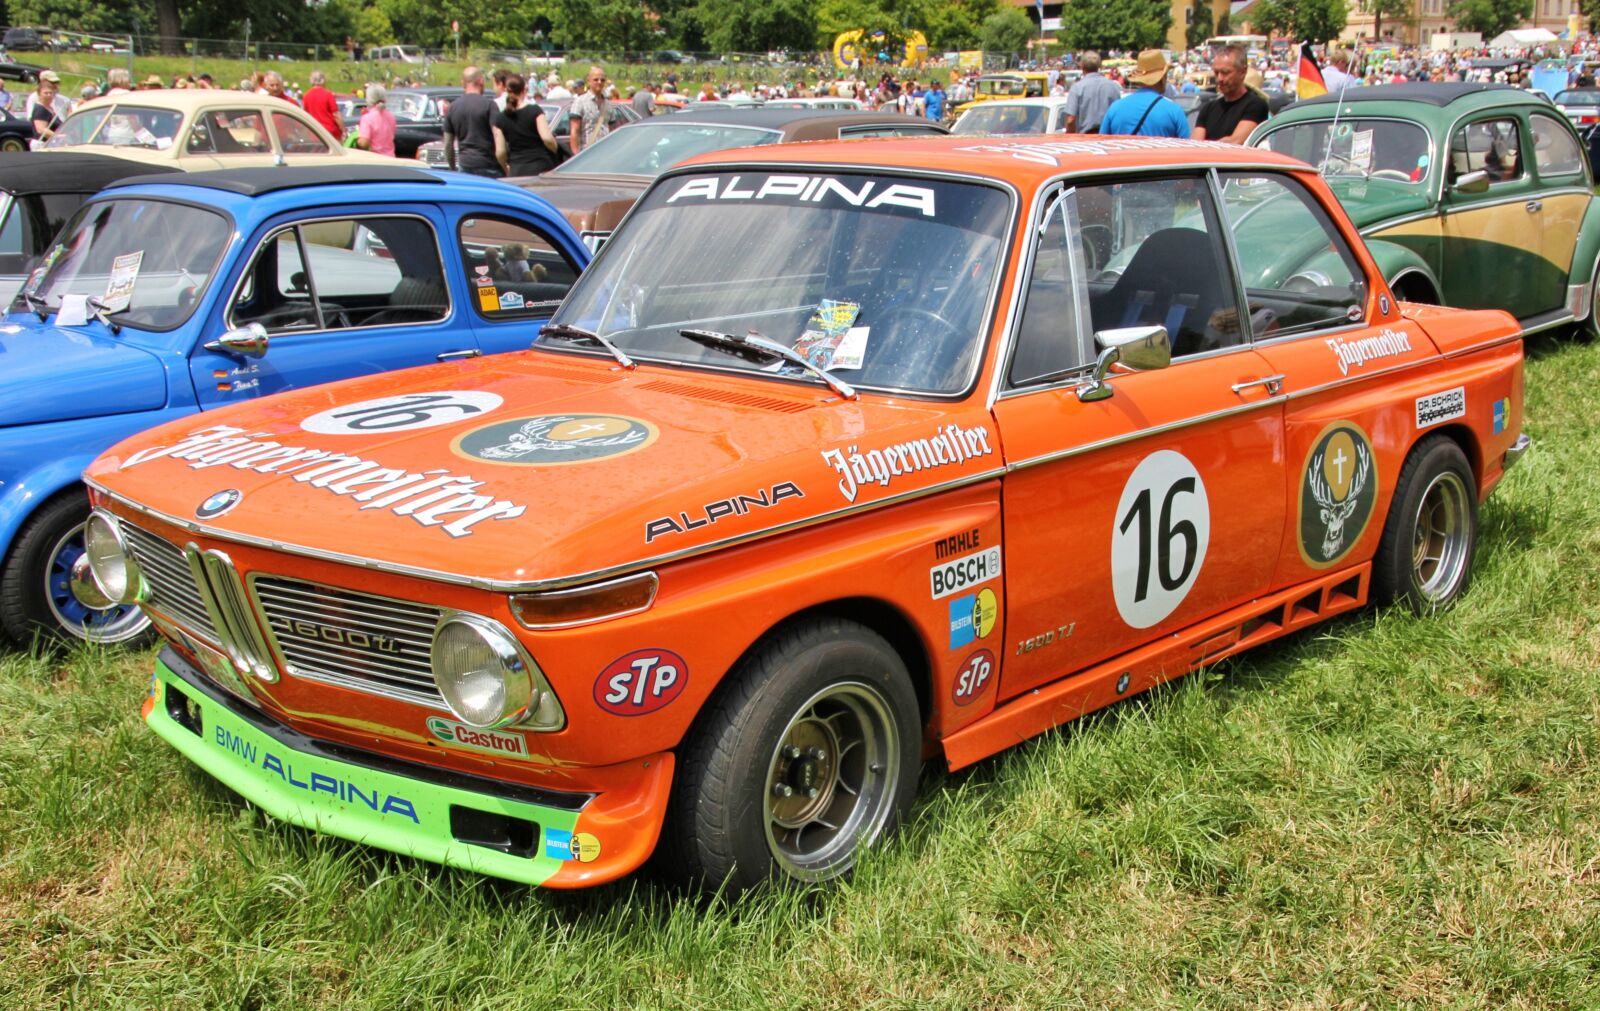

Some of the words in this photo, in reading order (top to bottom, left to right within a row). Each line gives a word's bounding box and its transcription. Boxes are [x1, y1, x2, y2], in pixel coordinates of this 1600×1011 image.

[666, 176, 935, 216] ALPINA
[331, 396, 482, 430] 16
[820, 423, 993, 503] Jägermeister
[645, 481, 806, 544] ALPINA
[935, 529, 980, 559] MAHLE
[1119, 476, 1198, 604] 16
[933, 554, 987, 595] BOSCH
[951, 614, 972, 632] BILSTEIN
[1016, 631, 1055, 656] 1600
[605, 656, 678, 705] STP
[956, 655, 991, 697] STP
[455, 725, 522, 753] Castrol
[216, 725, 257, 764] BMW
[262, 752, 420, 825] ALPINA
